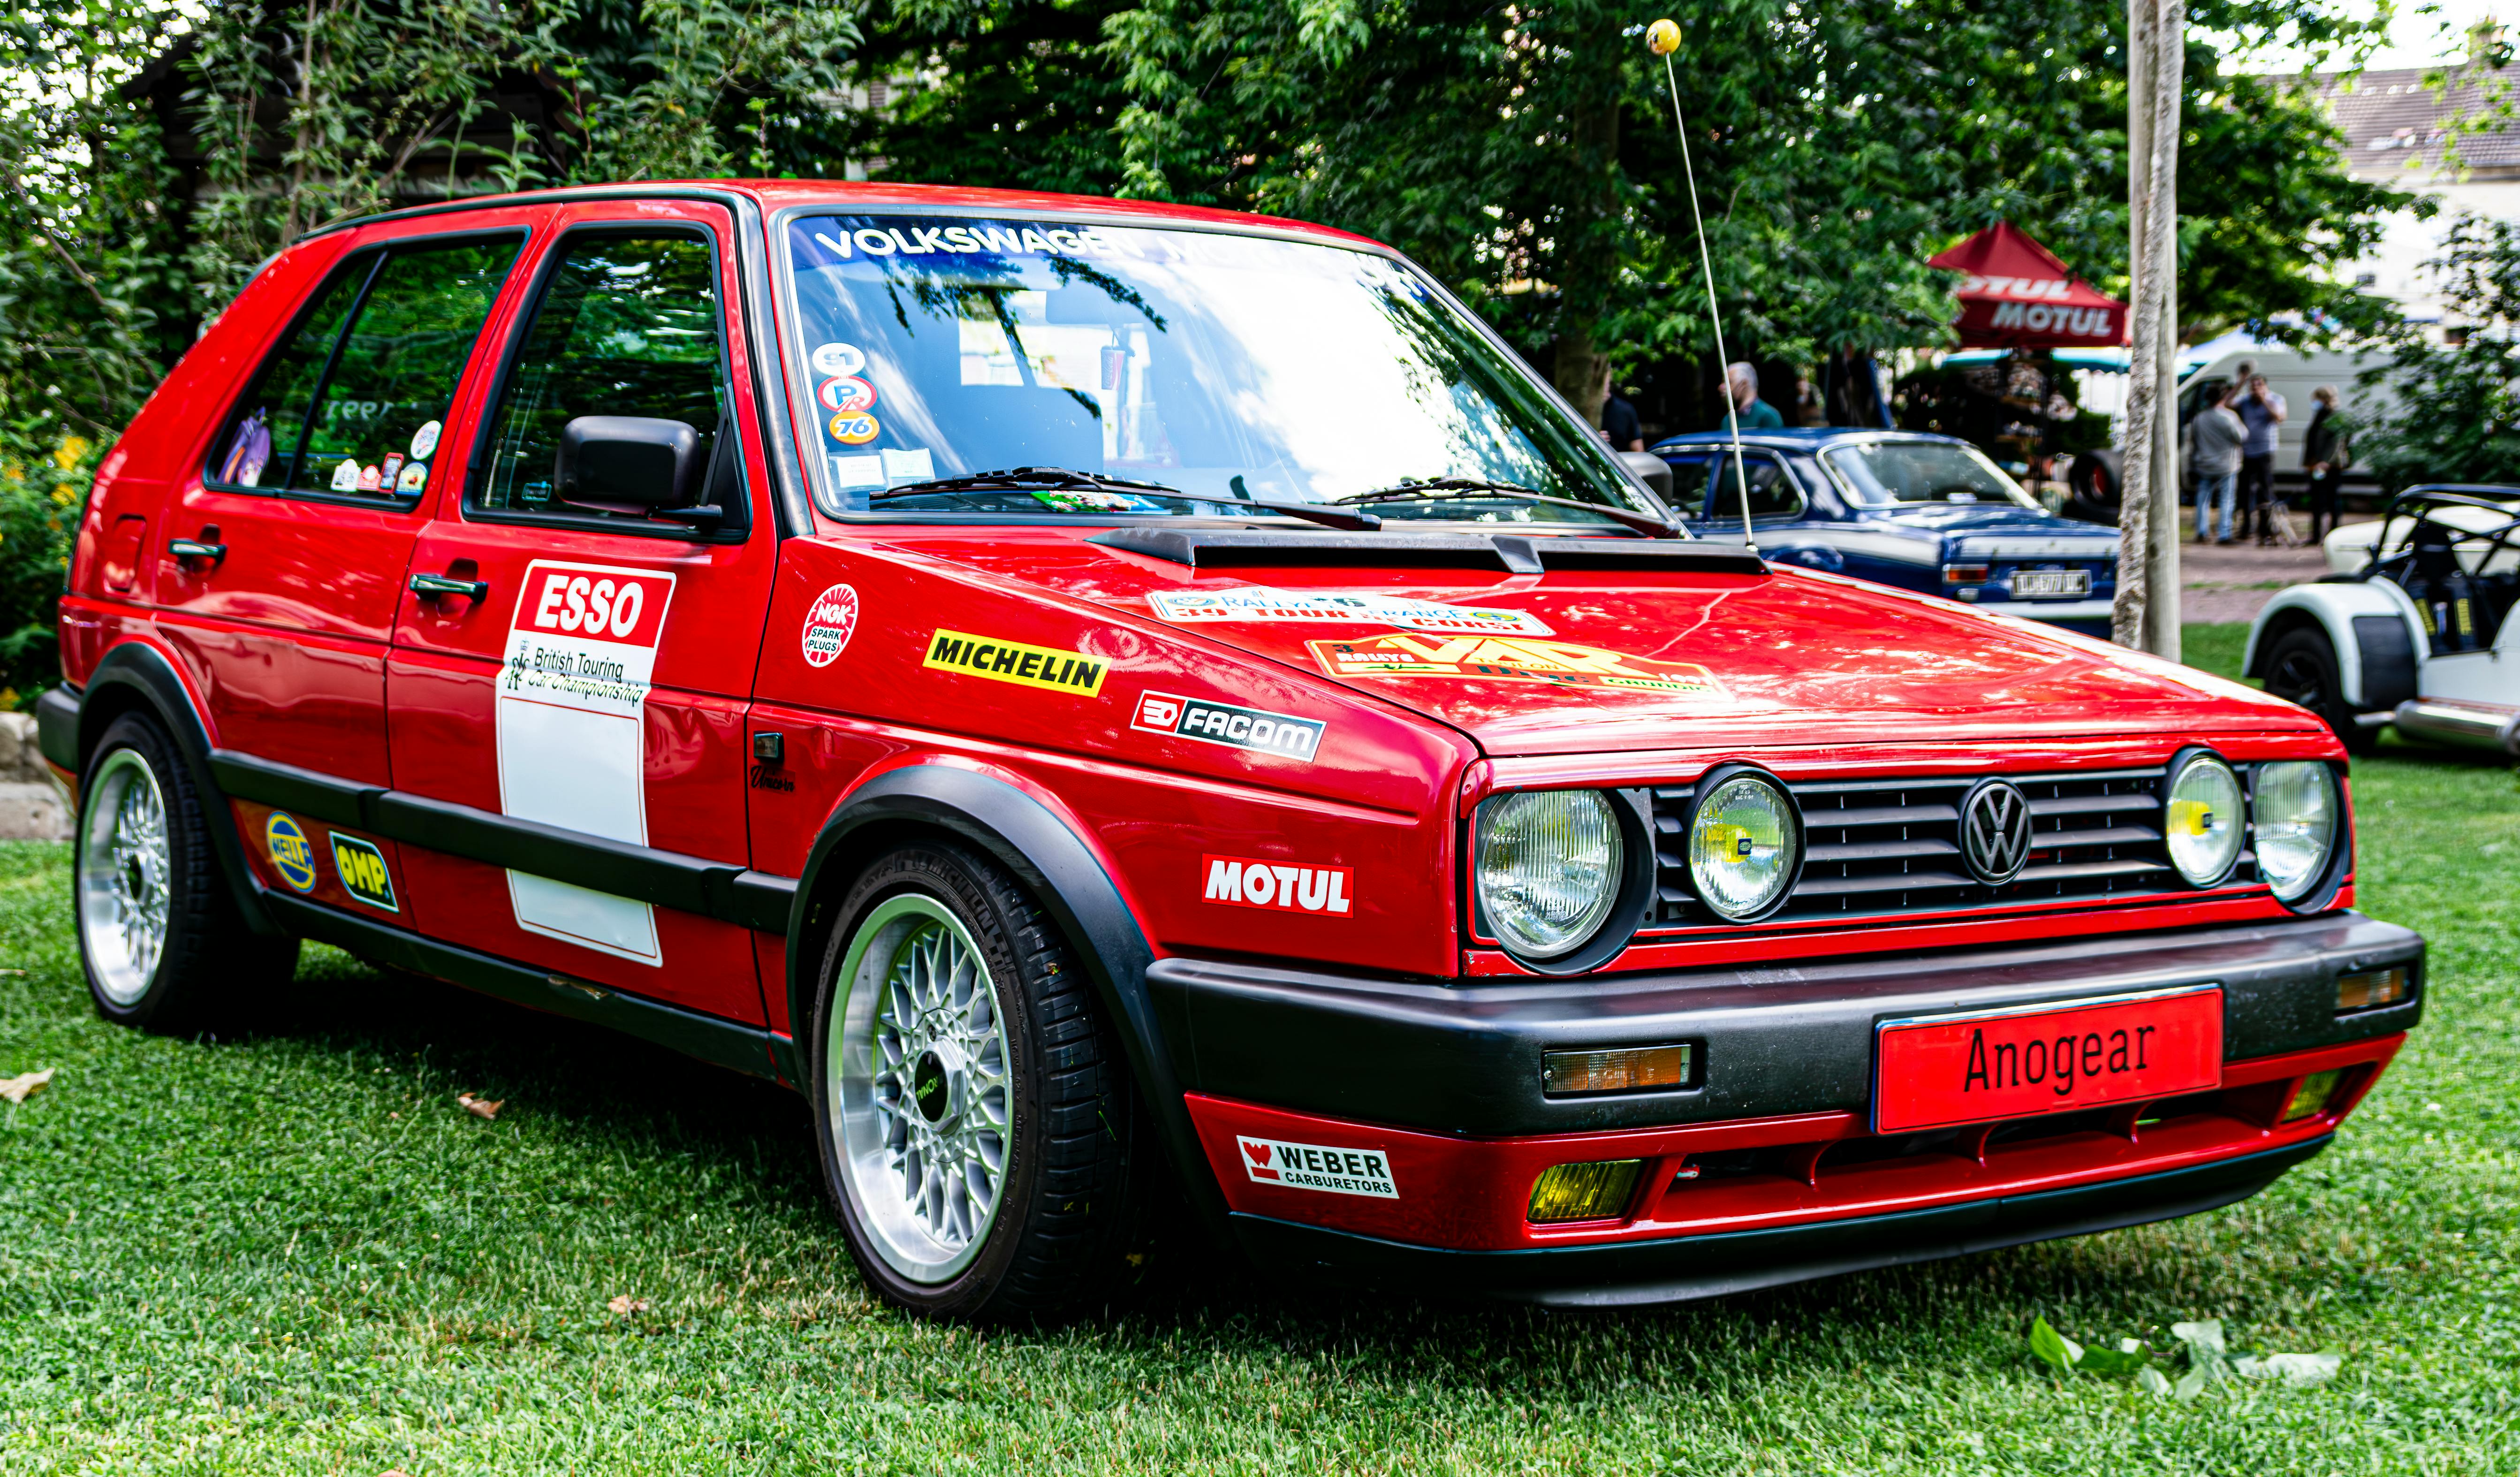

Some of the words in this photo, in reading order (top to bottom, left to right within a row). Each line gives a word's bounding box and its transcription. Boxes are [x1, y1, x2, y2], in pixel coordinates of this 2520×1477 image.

[815, 227, 1146, 258] VOLKSWAGEN
[1990, 300, 2113, 337] MOTUL
[837, 417, 873, 436] 76
[534, 573, 644, 638] ESSO
[815, 602, 852, 625] NGK
[1221, 596, 1316, 609] RALLYE
[1250, 609, 1351, 618] TOUR
[1411, 618, 1532, 631] CORSE
[807, 639, 838, 652] PLUGS
[811, 628, 842, 640] SPARK
[534, 647, 573, 671] British
[578, 652, 624, 683] Touring
[931, 636, 1101, 689] MICHELIN
[528, 669, 552, 688] Car
[552, 672, 644, 707] Championship
[1608, 678, 1712, 693] GRUNDIG
[1184, 707, 1315, 751] FACOM
[337, 845, 386, 896] OMP
[1206, 860, 1351, 913] MOTUL
[928, 858, 995, 930] MICHELIN
[1963, 1025, 2156, 1096] Anogear
[1276, 1145, 1388, 1179] WEBER
[1285, 1172, 1392, 1194] CARBURETORS
